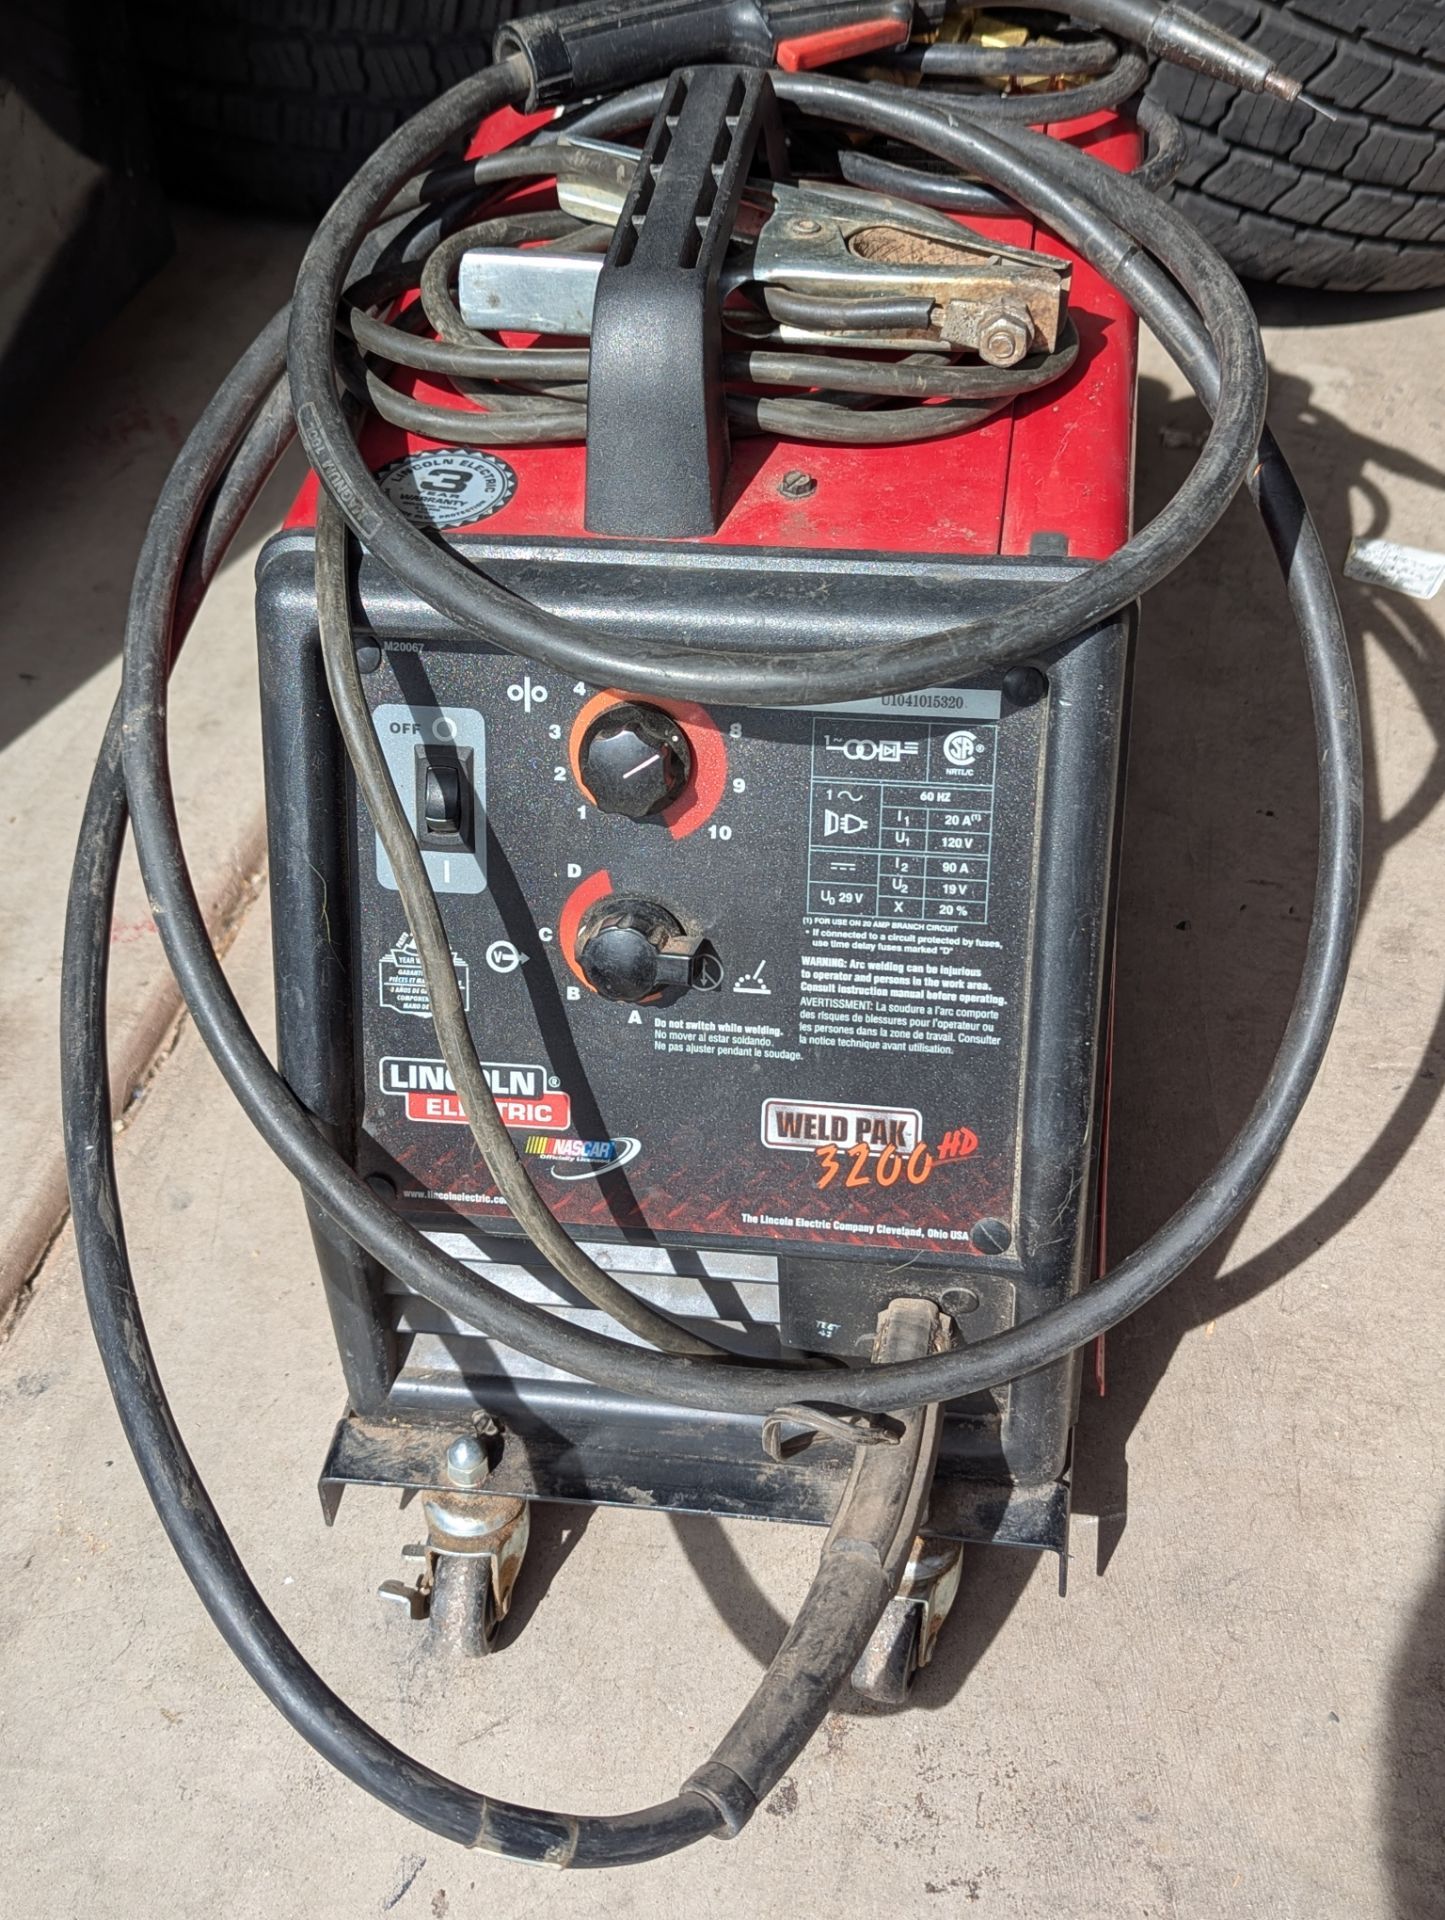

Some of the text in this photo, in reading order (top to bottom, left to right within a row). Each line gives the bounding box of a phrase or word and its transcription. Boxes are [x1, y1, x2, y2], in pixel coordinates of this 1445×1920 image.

[392, 458, 497, 494] LINCOLN ELECTRIC
[420, 468, 473, 493] 3
[321, 459, 369, 521] MAGNUM
[400, 493, 468, 507] WARRANTY
[383, 641, 425, 653] M20067
[573, 681, 587, 696] 4
[881, 695, 964, 709] U1041015320
[389, 721, 421, 735] OFF
[548, 724, 562, 740] 3
[729, 722, 742, 738] 8
[553, 766, 567, 781] 2
[732, 778, 746, 793] 9
[920, 792, 952, 802] 60 HZ
[577, 804, 587, 820] 1
[944, 814, 960, 826] 20
[707, 825, 732, 840] 10
[942, 837, 963, 848] 120
[964, 838, 974, 849] V
[567, 863, 582, 878] D
[942, 863, 957, 873] 90
[960, 864, 969, 874] A
[838, 892, 864, 903] 29 V
[943, 884, 957, 894] 19
[958, 884, 968, 895] V
[893, 901, 904, 913] X
[939, 904, 954, 915] 20
[814, 917, 831, 925] FOR
[832, 918, 848, 926] USE
[849, 919, 861, 927] ON
[891, 921, 925, 931] BRANCH
[926, 924, 958, 932] CIRCUIT
[538, 927, 553, 942] C
[812, 928, 820, 937] If
[820, 929, 867, 940] connected
[868, 932, 878, 940] to
[887, 933, 916, 942] circuit
[917, 936, 960, 945] protected
[962, 937, 974, 948] by
[975, 938, 1003, 950] fuses,
[830, 939, 850, 949] time
[851, 941, 876, 952] delay
[877, 942, 902, 952] fuses
[903, 945, 938, 955] marked
[801, 955, 982, 977] WARNING: Arc welding can be injurious
[801, 969, 992, 991] to operator and persons in the work area.
[567, 986, 580, 1000] B
[800, 981, 1008, 1007] Consult instruction manual before operating.
[627, 1010, 643, 1024] A
[875, 1001, 887, 1012] La
[888, 1003, 926, 1014] soudure
[955, 1009, 999, 1020] comporte
[655, 1017, 784, 1037] Do not switch while welding.
[800, 1009, 816, 1019] des
[817, 1010, 850, 1023] risques
[851, 1012, 864, 1023] de
[865, 1014, 907, 1026] blessures
[909, 1018, 931, 1028] pour
[982, 1023, 995, 1032] ou
[655, 1029, 774, 1047] No mover al estar soldando.
[798, 1021, 812, 1032] les
[856, 1026, 878, 1036] dans
[879, 1027, 888, 1037] la
[889, 1029, 911, 1039] zone
[912, 1029, 924, 1040] de
[925, 1031, 956, 1042] travail.
[957, 1032, 1001, 1046] Consulter
[655, 1040, 804, 1062] Ne pas ajuster pendant le soudage.
[798, 1033, 954, 1055] la notice technique avant utilisation.
[390, 1064, 535, 1096] LINLN
[426, 1097, 553, 1122] ELTRIC
[775, 1111, 908, 1147] WELD PAK
[551, 1138, 610, 1158] NASCAR
[814, 1126, 980, 1190] 3200 HD
[403, 1189, 508, 1205] www.lincolnelectric.co
[741, 1213, 969, 1241] The Lincoln Electric Company Cleveland, Ohio USA
